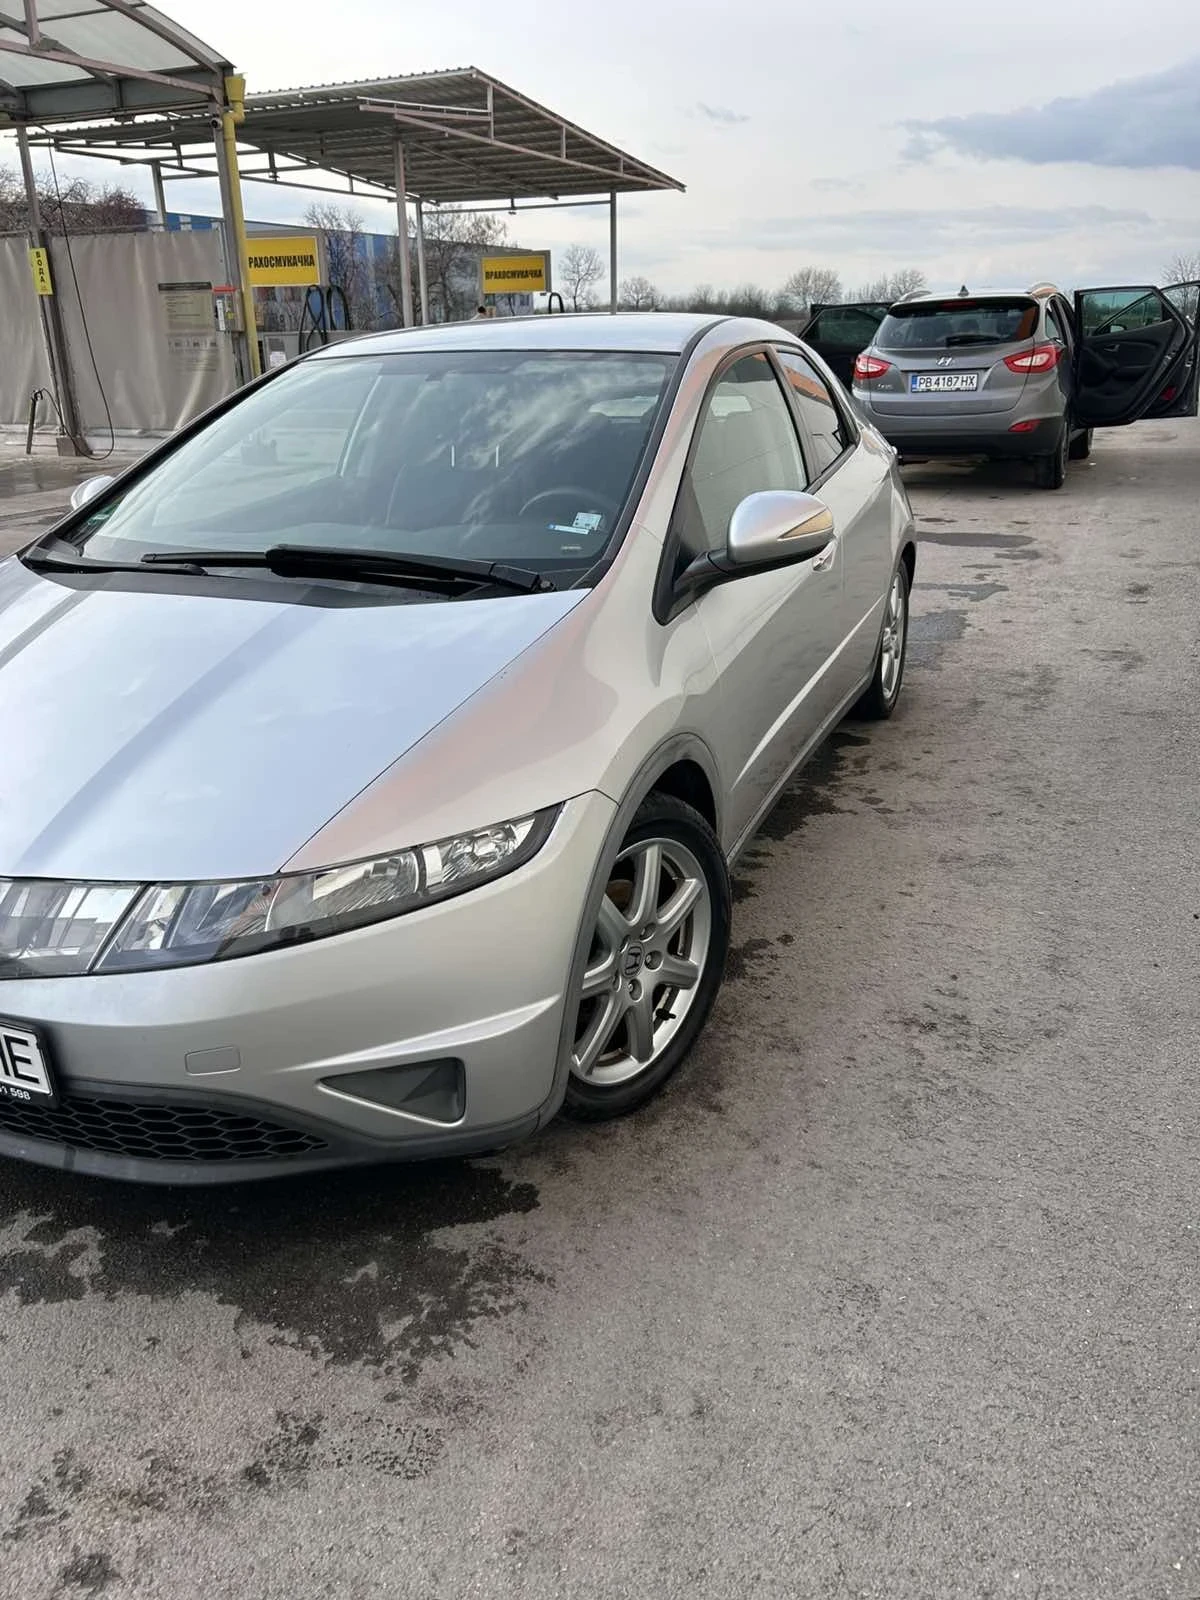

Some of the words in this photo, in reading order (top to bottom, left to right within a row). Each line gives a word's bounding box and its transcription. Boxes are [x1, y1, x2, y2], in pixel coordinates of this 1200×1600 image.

[35, 251, 46, 282] ВОДА
[248, 254, 315, 269] РАХОСМУКАЧКА
[918, 377, 932, 387] PB
[934, 376, 959, 387] 4187
[961, 375, 975, 386] HX
[0, 1034, 41, 1084] E
